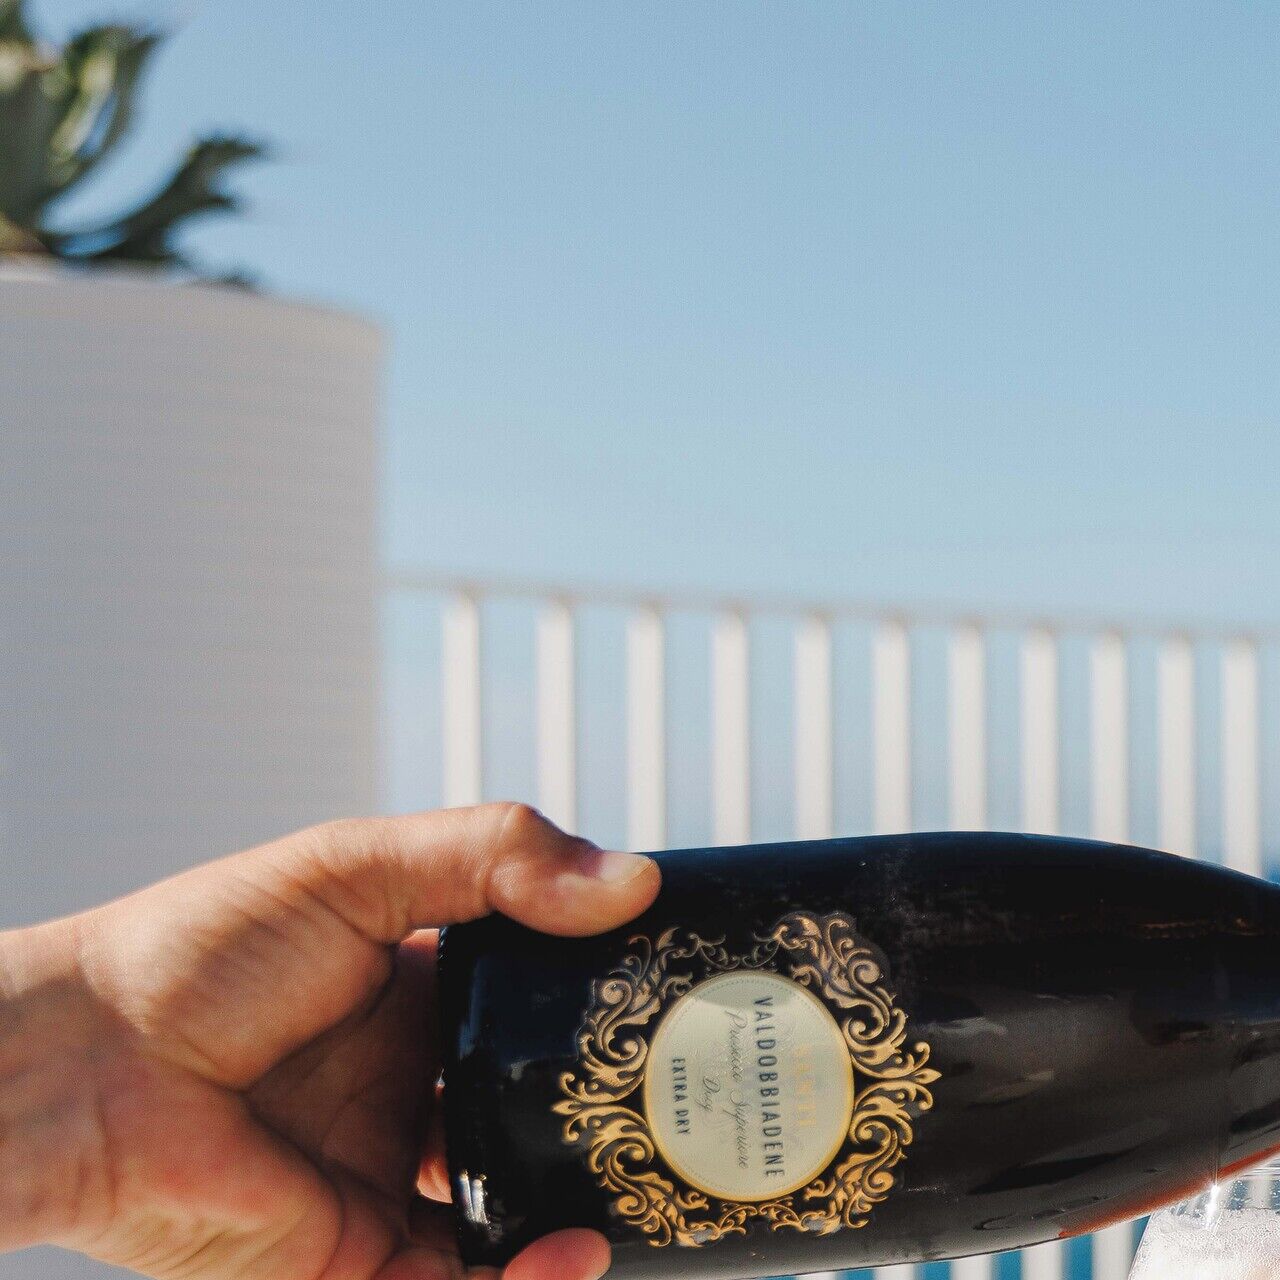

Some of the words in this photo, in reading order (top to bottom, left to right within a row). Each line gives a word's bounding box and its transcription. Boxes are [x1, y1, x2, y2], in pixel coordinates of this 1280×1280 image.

[671, 1057, 688, 1103] EXTRA
[753, 996, 785, 1178] VALDOBBIADENE
[675, 1109, 692, 1136] DRY
[723, 1090, 752, 1169] Superiore
